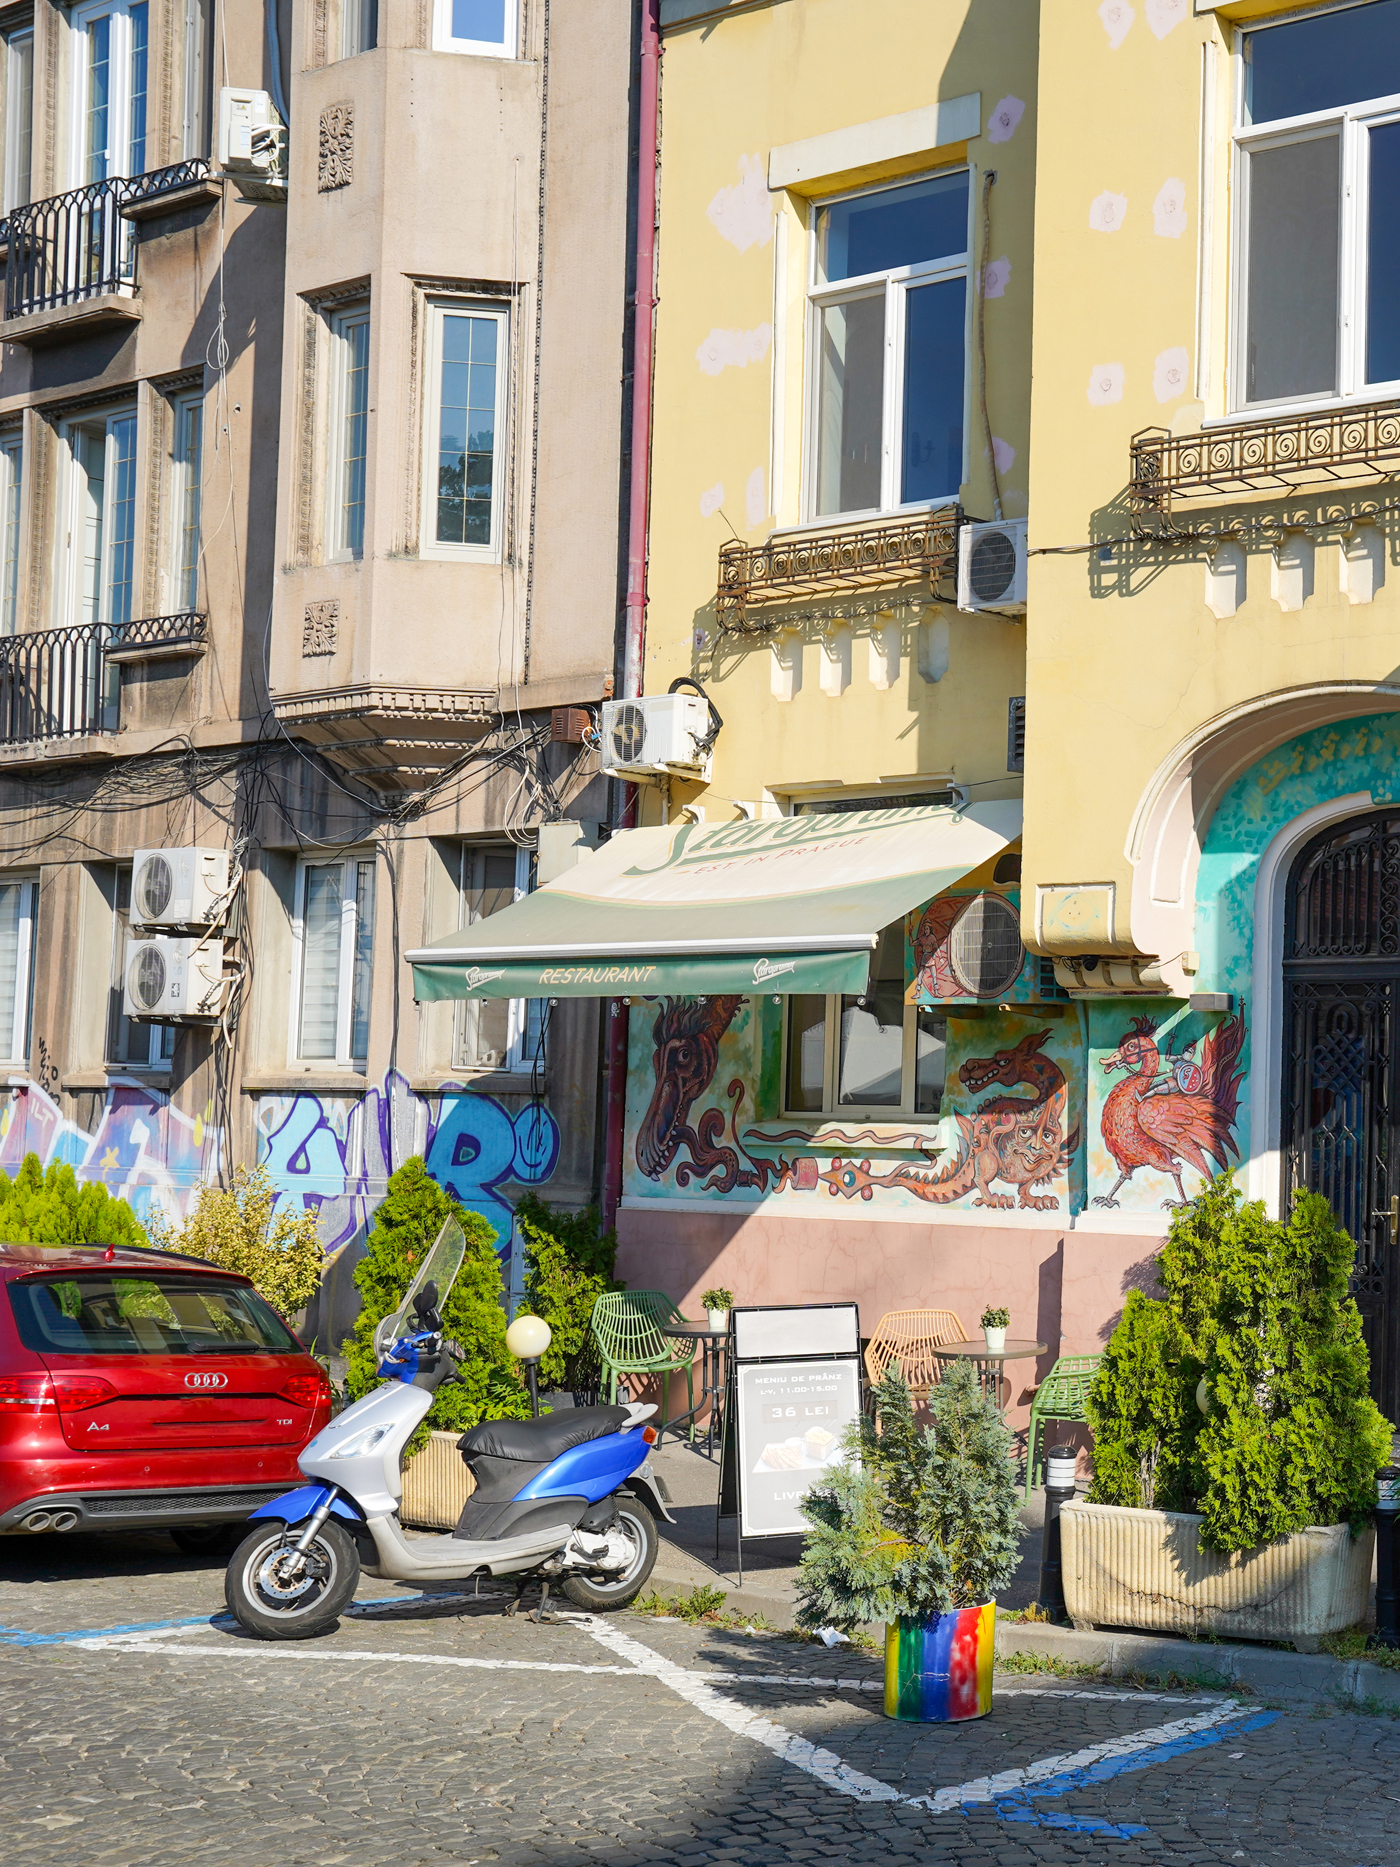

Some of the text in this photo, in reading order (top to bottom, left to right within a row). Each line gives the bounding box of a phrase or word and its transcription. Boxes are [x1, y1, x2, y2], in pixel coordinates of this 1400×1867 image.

[694, 836, 869, 874] EST IN PRAGUE
[465, 966, 506, 991] Staropramen
[539, 966, 656, 984] RESTAURANT
[809, 1372, 842, 1381] PRÂNZ
[772, 1406, 829, 1418] 36 LEI
[87, 1422, 110, 1432] A4
